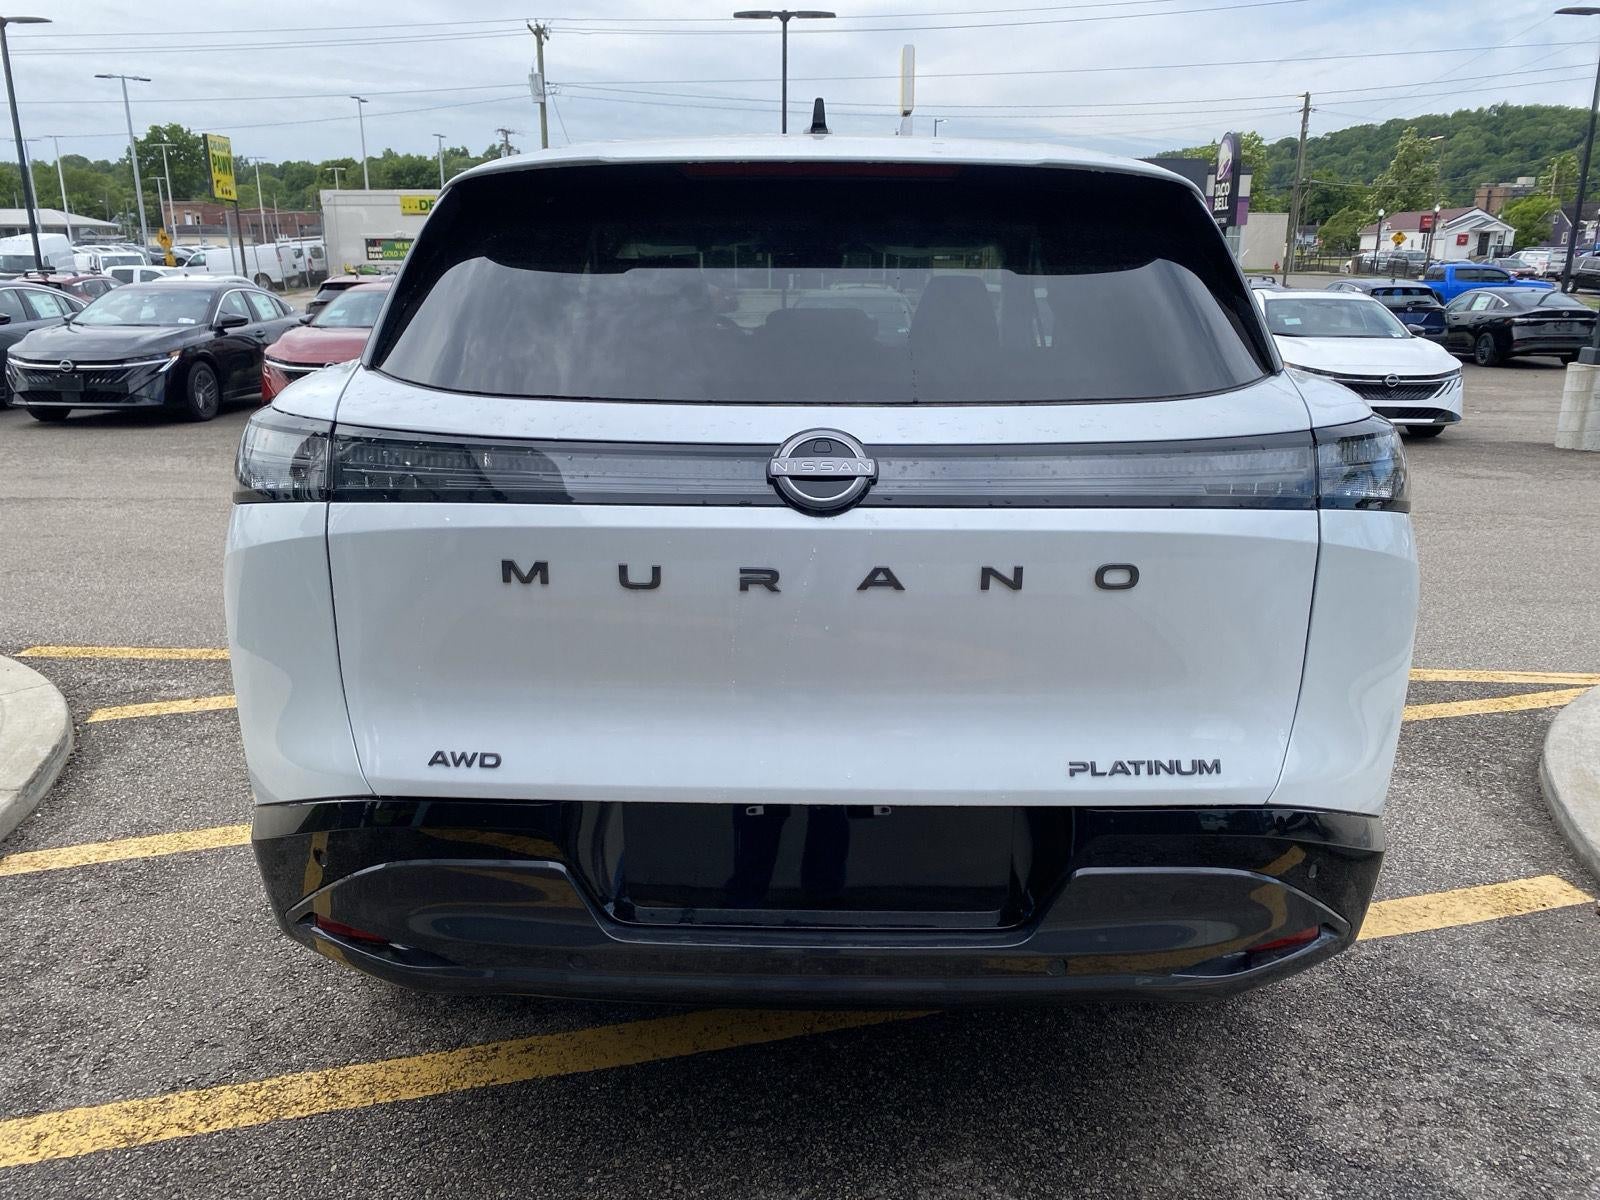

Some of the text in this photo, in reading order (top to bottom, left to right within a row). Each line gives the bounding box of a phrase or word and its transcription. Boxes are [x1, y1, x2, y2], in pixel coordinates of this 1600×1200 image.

[211, 153, 233, 176] PAWN
[1215, 182, 1230, 197] TACO
[1214, 197, 1229, 210] BELL
[383, 250, 398, 258] GOLD
[773, 460, 873, 473] NISSAN
[501, 559, 1141, 593] MURANO
[427, 750, 502, 769] AWD
[1068, 758, 1221, 777] PLATINUM
